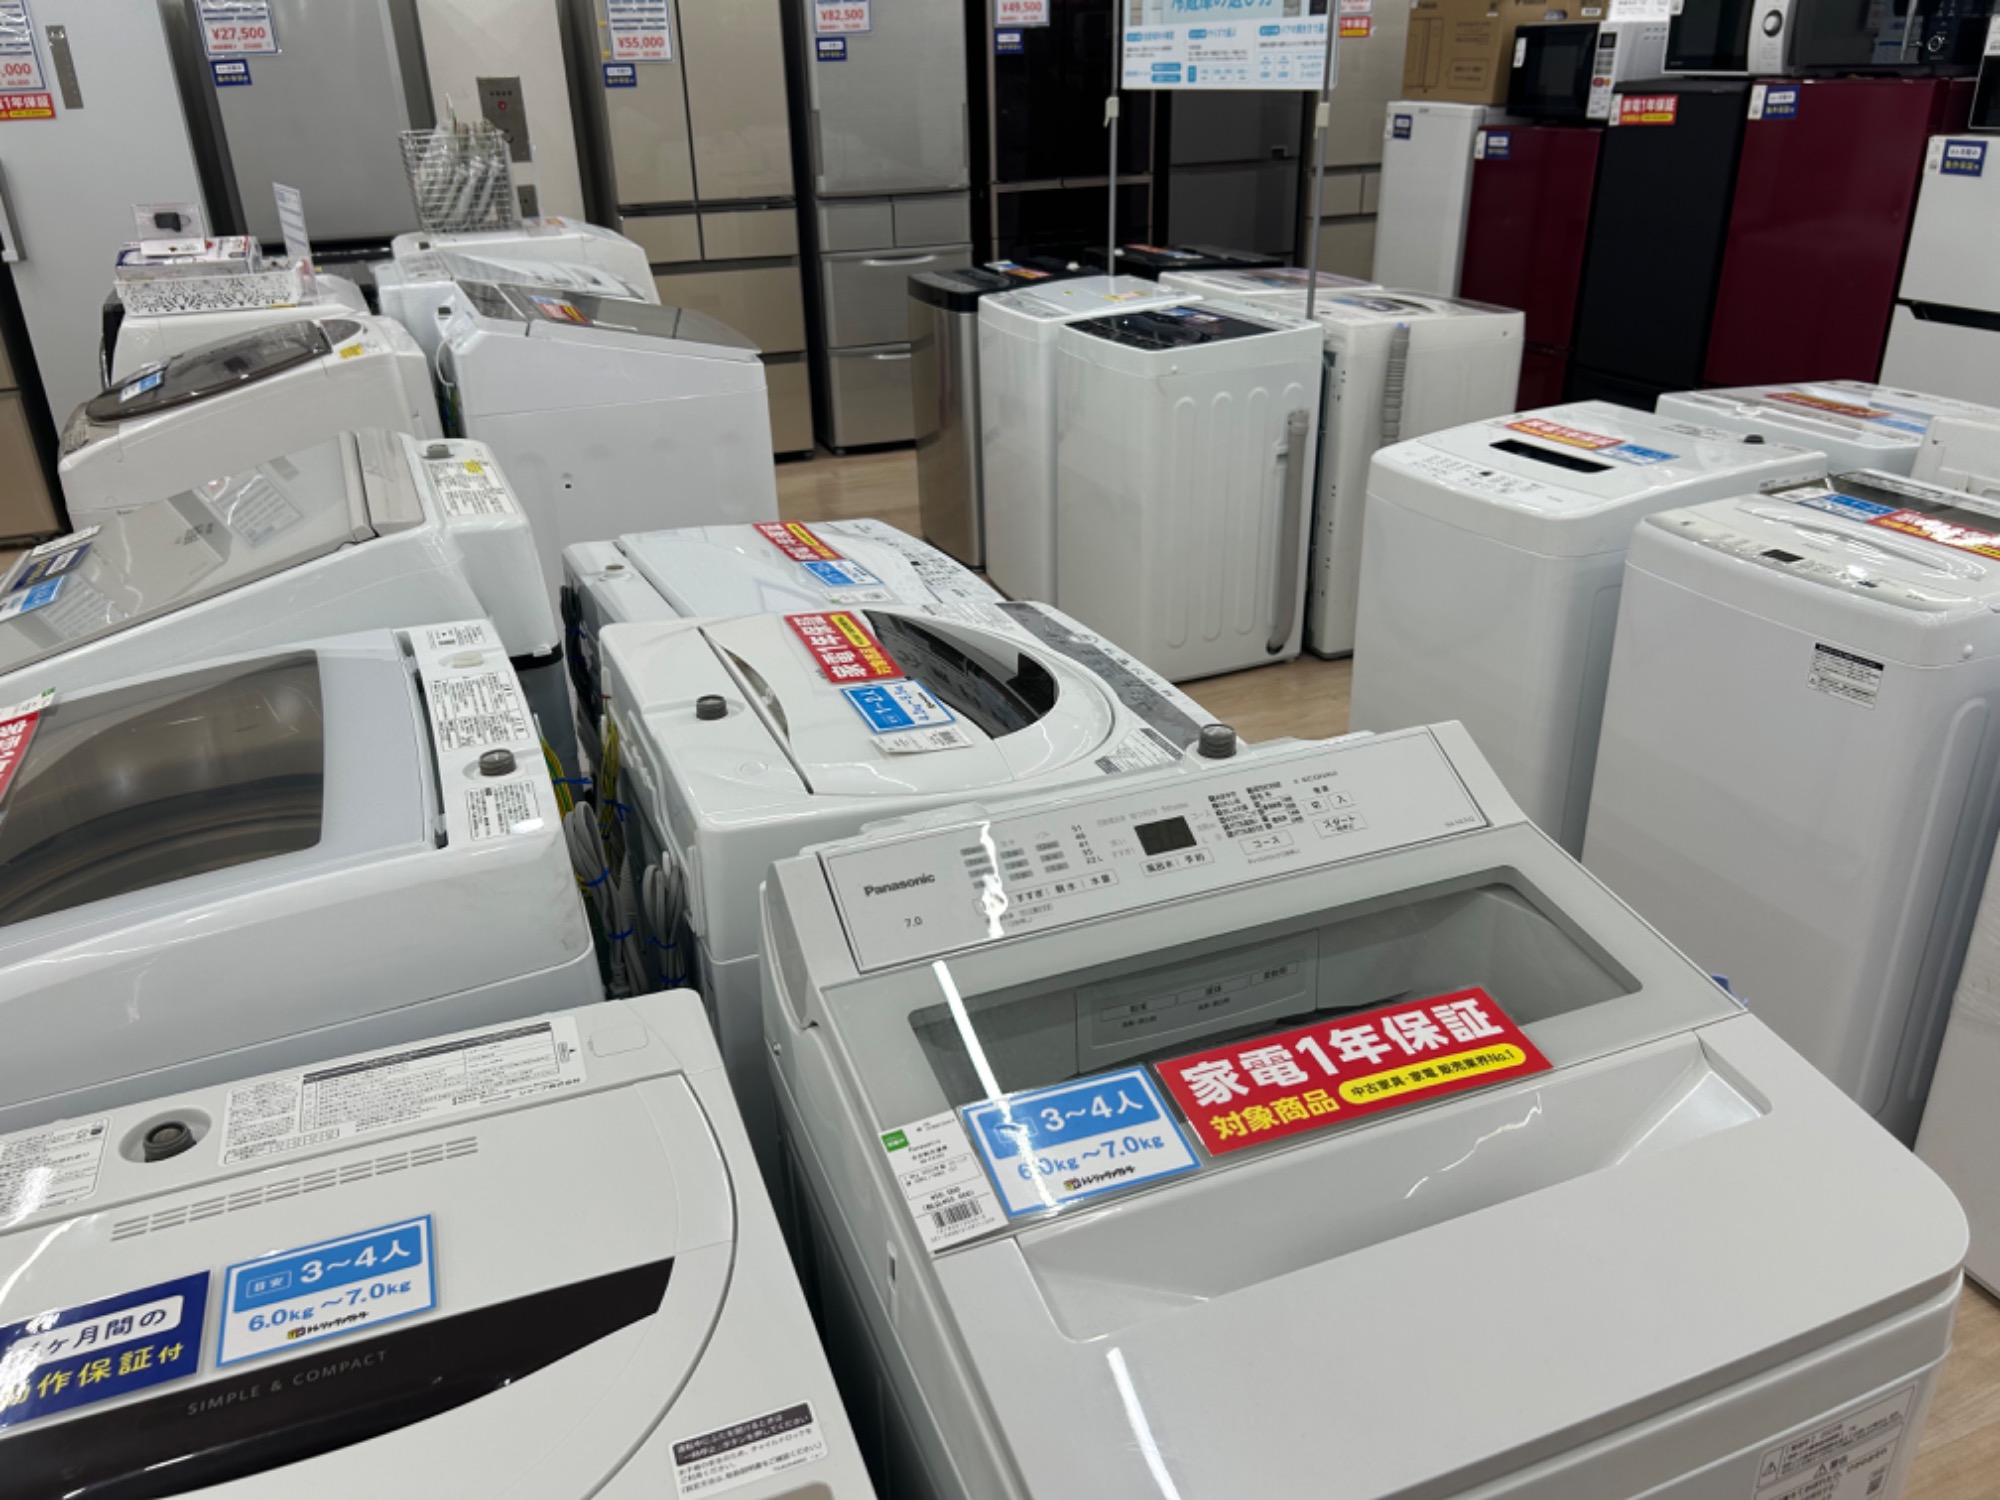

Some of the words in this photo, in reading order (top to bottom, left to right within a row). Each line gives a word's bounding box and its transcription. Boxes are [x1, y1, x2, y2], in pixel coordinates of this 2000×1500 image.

[211, 26, 266, 41] ¥27,500
[617, 36, 665, 50] ¥55,000
[1252, 836, 1281, 848] コース
[863, 872, 936, 898] Panasonic
[904, 915, 924, 929] 7.0
[1180, 997, 1505, 1107] 家電1年保証
[1209, 1088, 1341, 1141] 対象商品
[187, 1384, 262, 1416] SIMPLE
[270, 1380, 283, 1393] &
[292, 1350, 388, 1387] COMPACT
